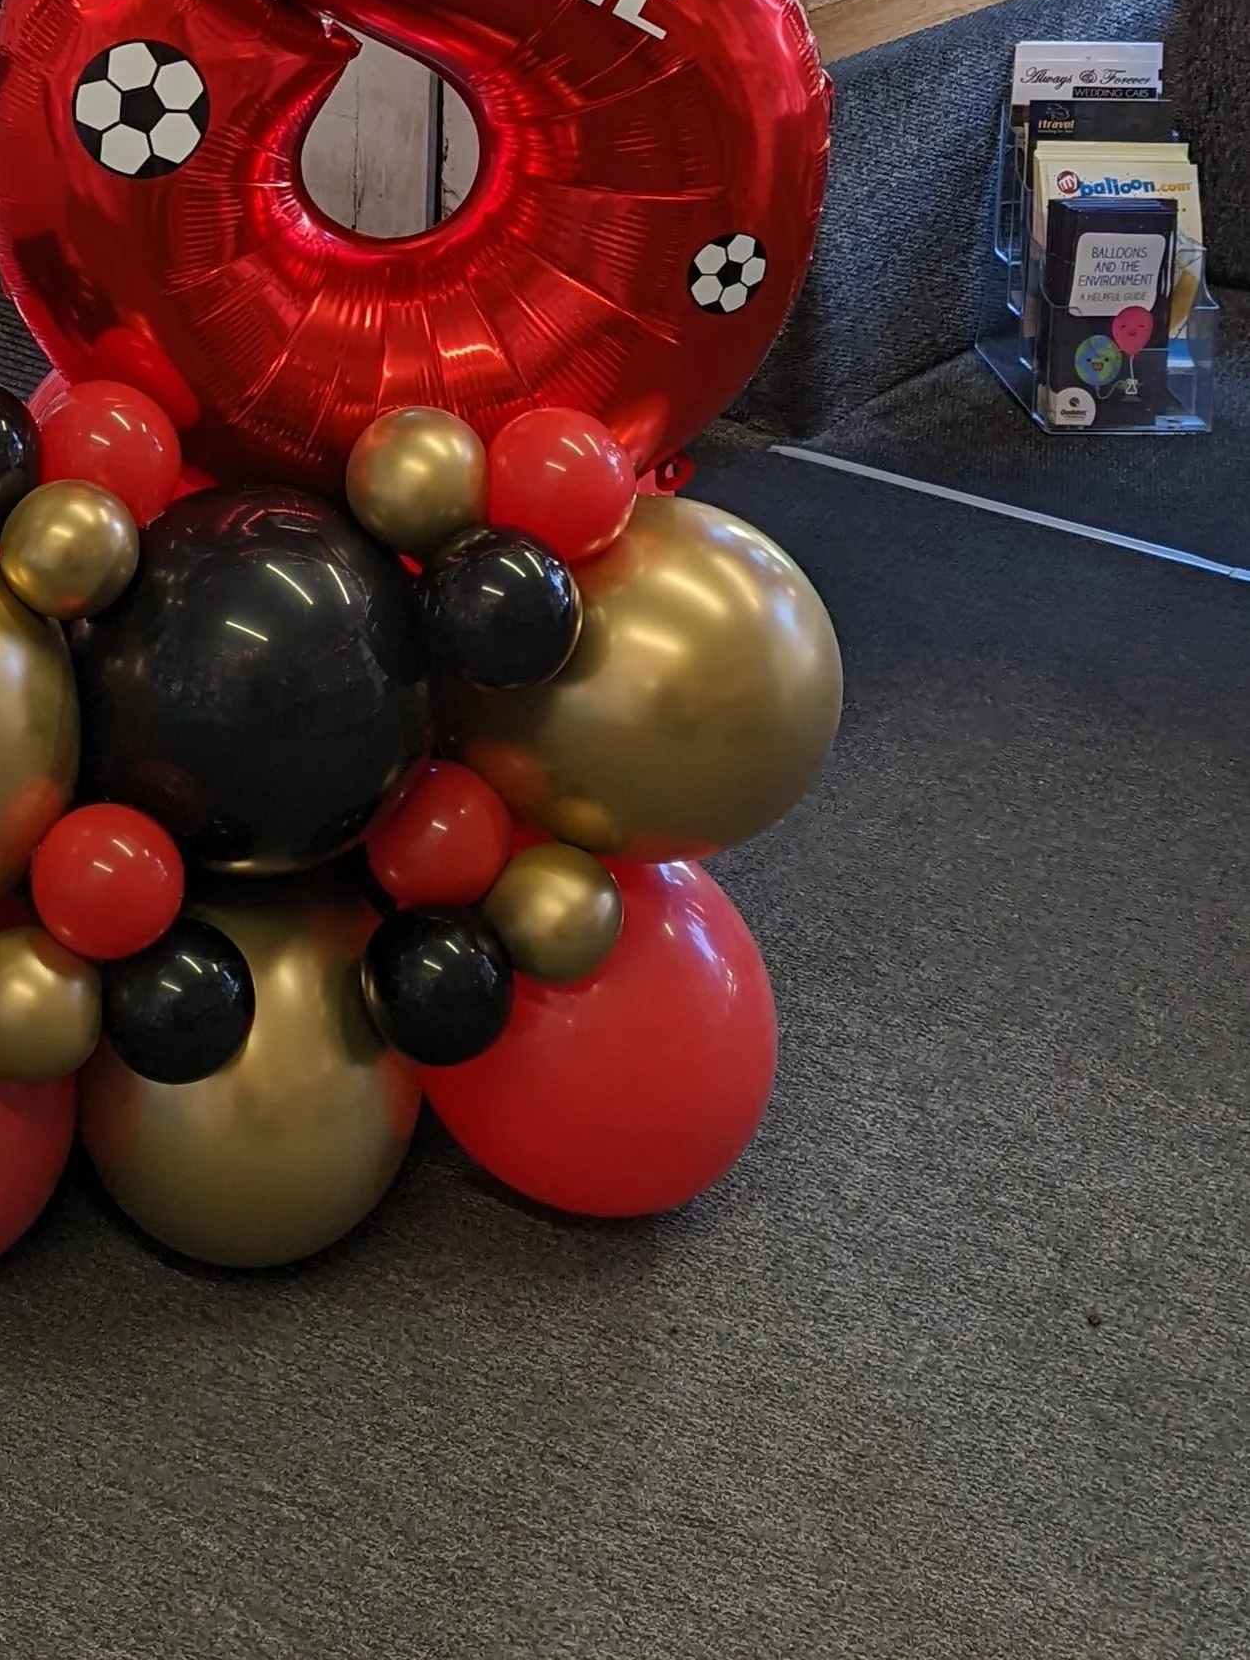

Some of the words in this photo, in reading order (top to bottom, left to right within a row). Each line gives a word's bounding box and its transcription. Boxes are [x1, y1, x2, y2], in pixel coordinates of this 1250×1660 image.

[1020, 66, 1072, 90] Always
[1100, 68, 1151, 85] Forever
[1074, 88, 1123, 98] WEDDING
[1125, 88, 1149, 98] CARS
[1091, 246, 1148, 259] BALLOONS
[1094, 261, 1116, 272] AND
[1121, 260, 1140, 272] THE
[1078, 274, 1154, 287] ENVIRONMENT
[1088, 292, 1121, 301] HELPFUL
[1123, 291, 1147, 301] GUIDE
